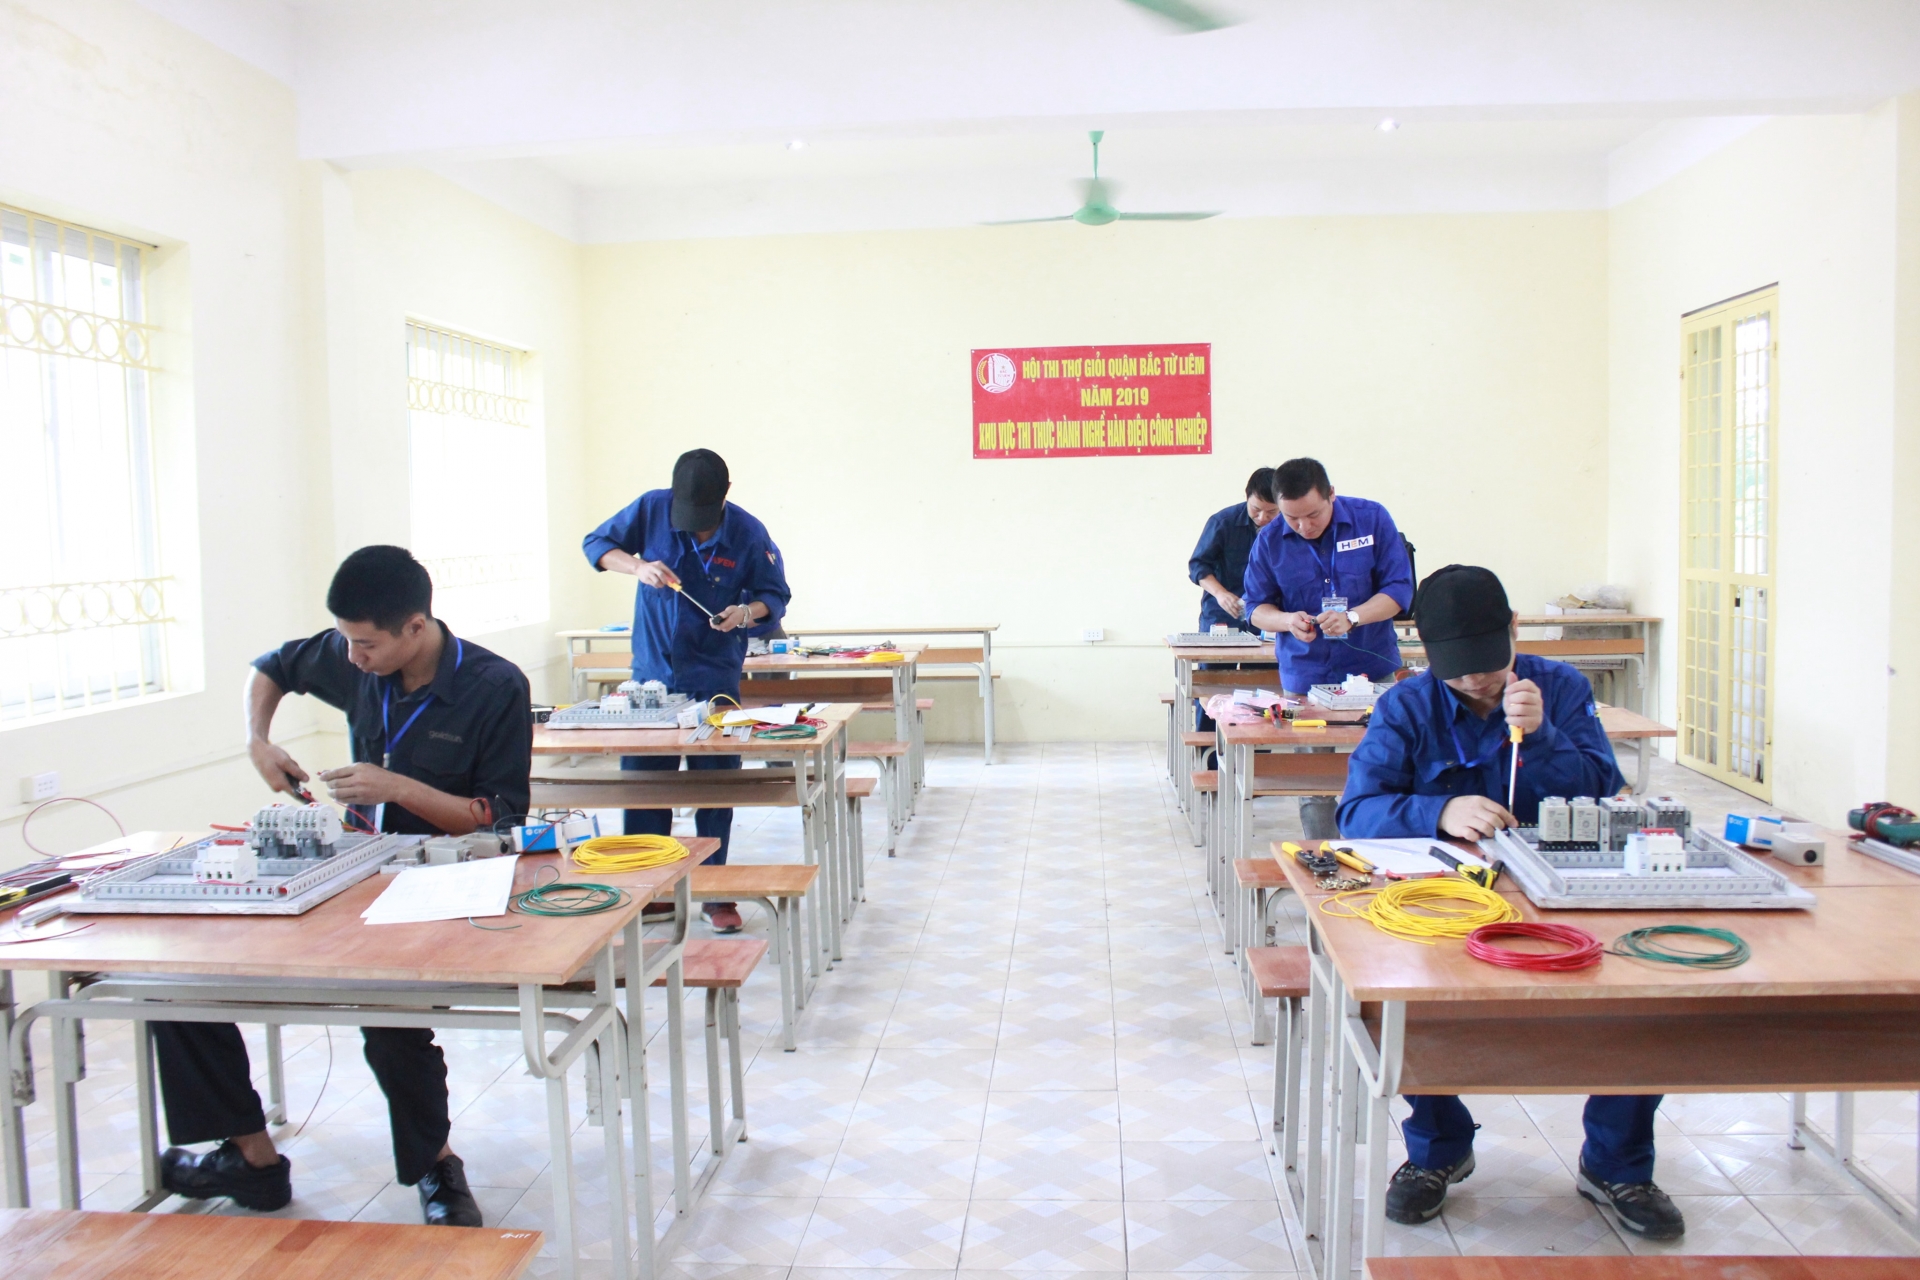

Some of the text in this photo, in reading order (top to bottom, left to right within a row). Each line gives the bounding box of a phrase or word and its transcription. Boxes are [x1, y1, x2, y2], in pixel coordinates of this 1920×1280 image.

[1023, 352, 1204, 382] HỘI THI THỢ GIỎI QUẬN BẮC TỪ LIÊM
[1081, 385, 1148, 406] NĂM 2019
[979, 411, 1207, 455] KHU VỰC THI THỰC HÀNH NGHỀ HÀN ĐIỆN CÔNG NGHIỆP
[1341, 537, 1370, 550] HEM
